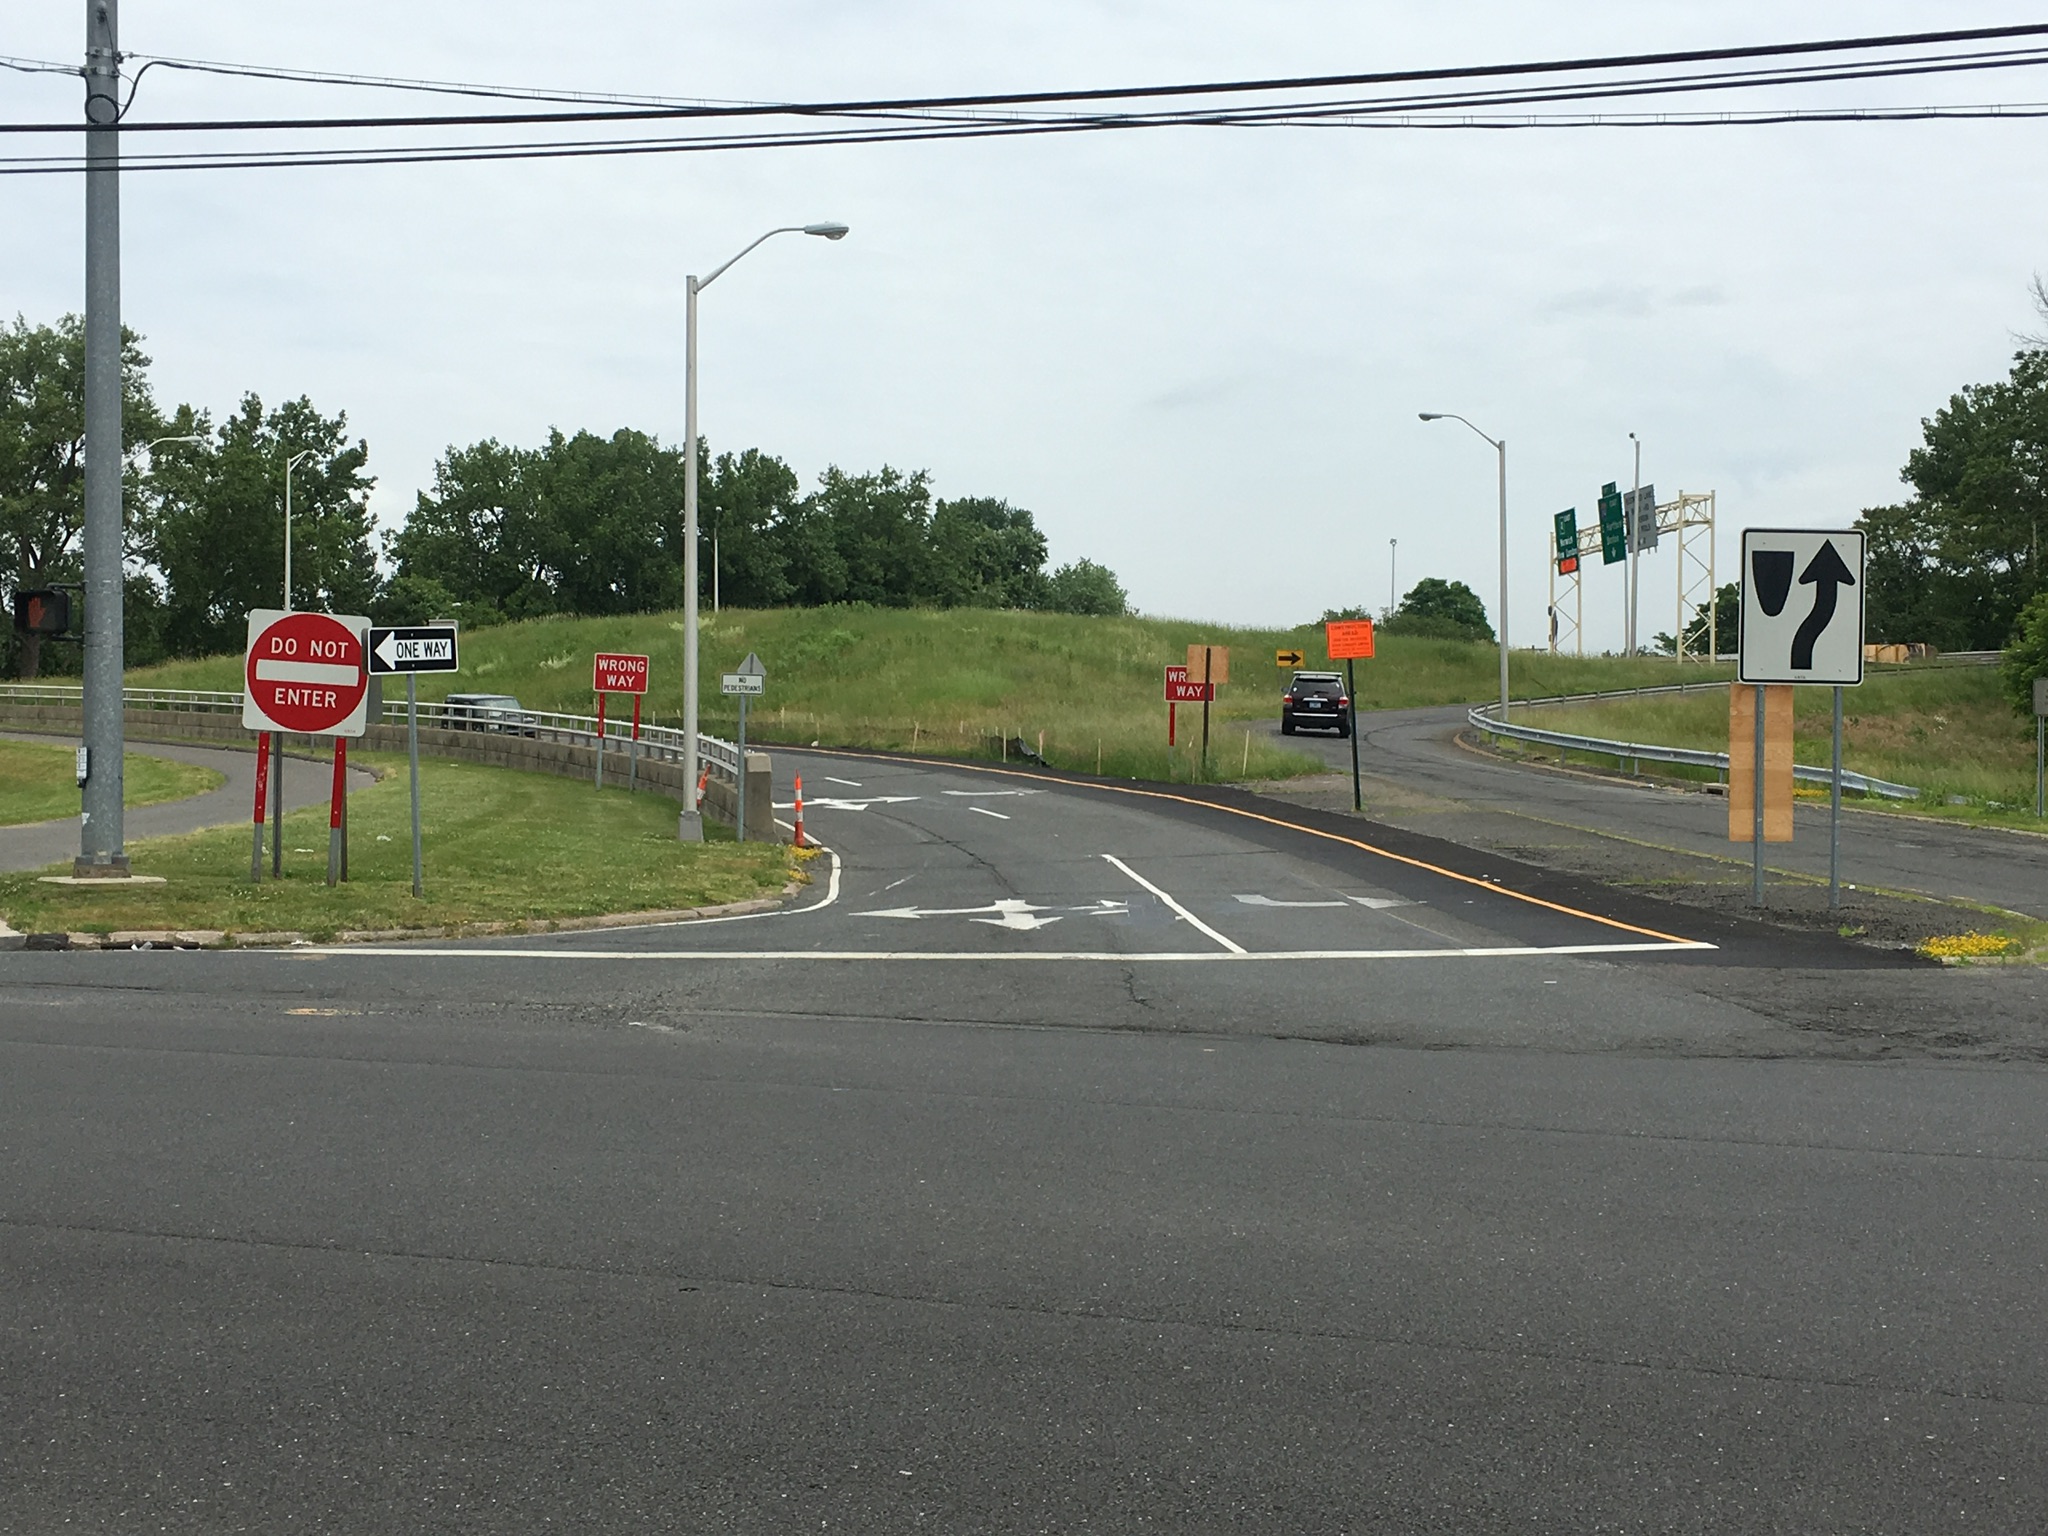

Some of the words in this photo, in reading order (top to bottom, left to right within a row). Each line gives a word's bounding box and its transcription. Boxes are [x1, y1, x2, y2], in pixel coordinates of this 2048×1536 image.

[271, 636, 297, 655] DO
[310, 640, 349, 659] NOT
[396, 642, 420, 659] ONE
[424, 640, 448, 658] WAY
[598, 659, 646, 673] WRONG
[606, 674, 636, 688] WAY
[274, 687, 337, 709] ENTER
[1176, 685, 1203, 698] WAY
